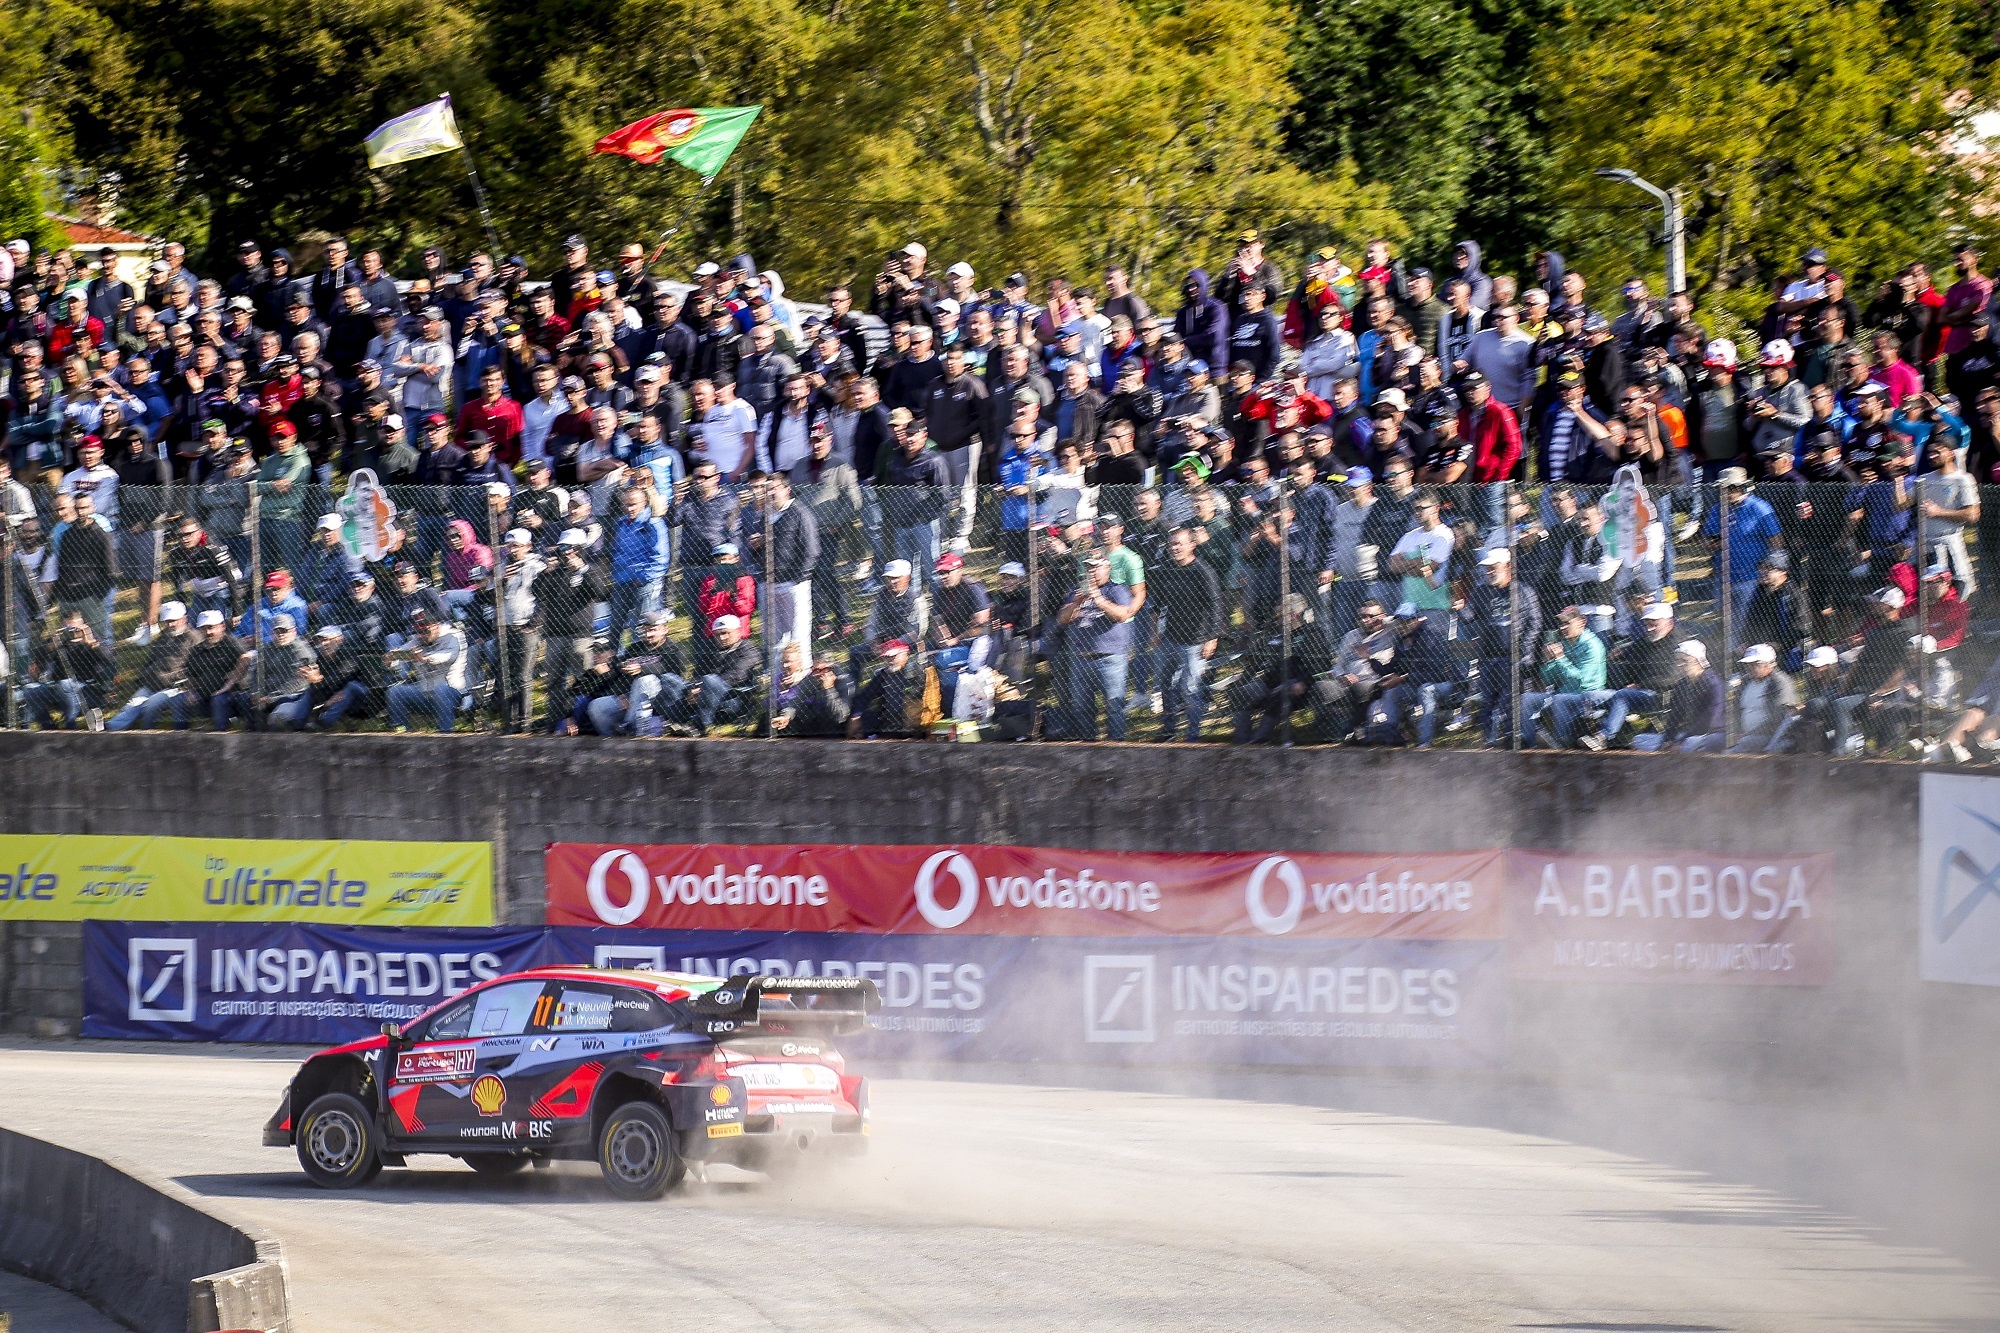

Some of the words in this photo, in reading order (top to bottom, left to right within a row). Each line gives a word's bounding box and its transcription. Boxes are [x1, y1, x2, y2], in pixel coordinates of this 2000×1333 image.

[205, 856, 227, 872] bp
[78, 882, 151, 897] ACTIVE
[204, 868, 368, 907] ultimate
[655, 864, 830, 907] vodafone
[985, 866, 1161, 913] vodafone
[1311, 871, 1473, 913] vodafone
[1534, 863, 1812, 919] A.BARBOSA
[387, 888, 463, 904] ACTIVE
[211, 948, 502, 997] INSPAREDES
[1172, 965, 1461, 1017] INSPAREDES
[211, 1001, 257, 1016] CENTRO
[259, 1001, 276, 1016] DE
[349, 1003, 367, 1017] DE
[366, 1000, 428, 1020] VEÍCULOS
[533, 995, 553, 1026] 11
[577, 1001, 614, 1012] Neuville
[614, 1000, 650, 1011] #ForCraig
[563, 1016, 574, 1025] M.
[707, 1020, 735, 1033] i20
[481, 1038, 521, 1047] INNOCEAN
[581, 1040, 605, 1049] WIA
[457, 1049, 473, 1071] HY
[461, 1126, 499, 1137] HYUNDAI
[502, 1120, 552, 1139] MOBIS
